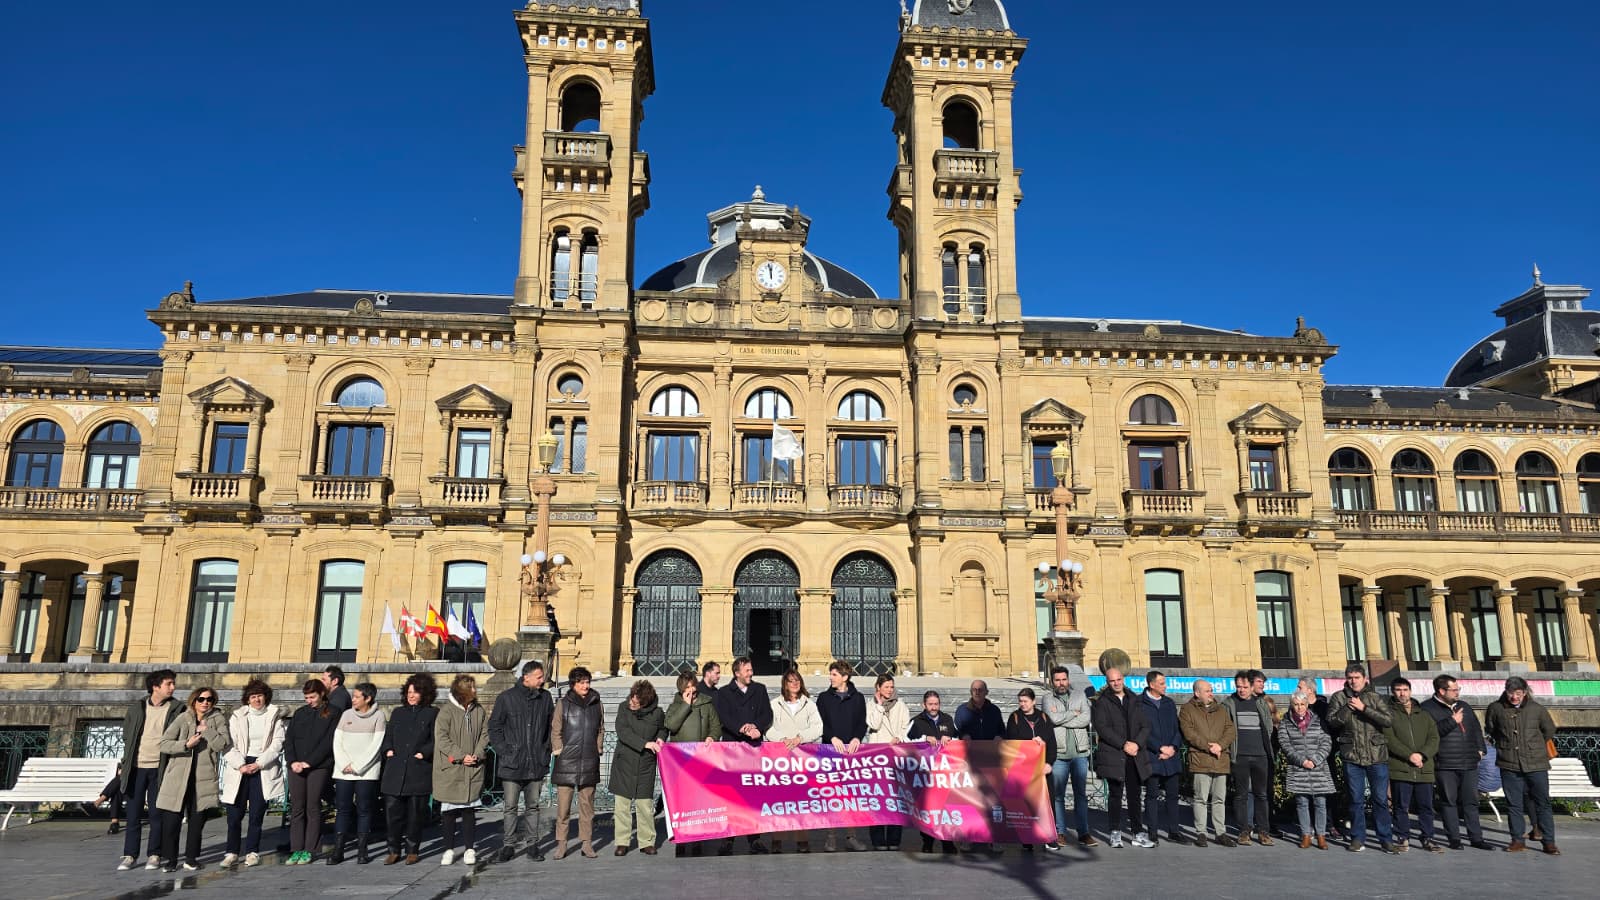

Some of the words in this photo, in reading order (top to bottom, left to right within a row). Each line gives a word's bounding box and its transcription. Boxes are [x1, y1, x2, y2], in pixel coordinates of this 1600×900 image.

[1131, 678, 1151, 689] Ud
[761, 754, 889, 773] DONOSTIAKO
[894, 754, 951, 772] UDALA
[741, 774, 808, 786] ERASO
[815, 767, 906, 785] SEXISTEN
[912, 771, 974, 789] AURKA
[808, 783, 882, 799] CONTRA
[887, 783, 914, 803] LAS
[760, 798, 881, 817] AGRESIONES
